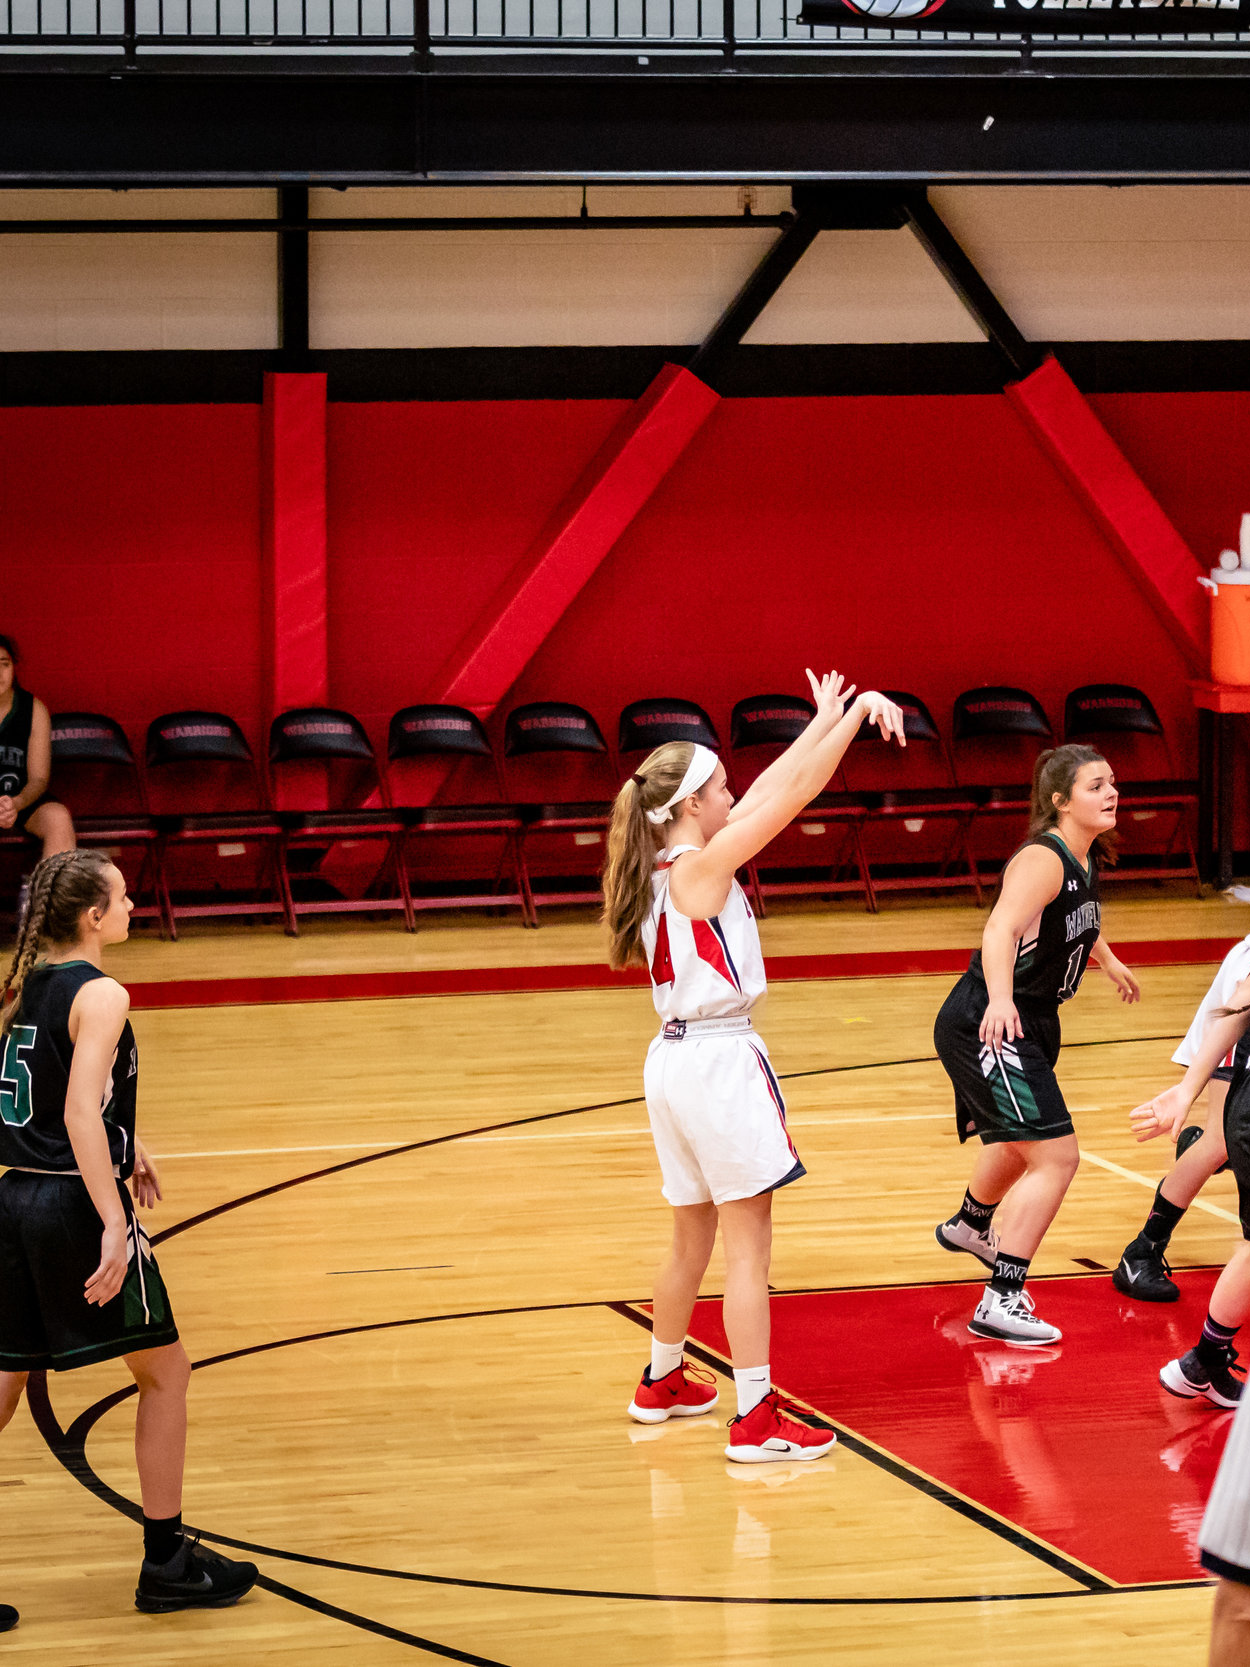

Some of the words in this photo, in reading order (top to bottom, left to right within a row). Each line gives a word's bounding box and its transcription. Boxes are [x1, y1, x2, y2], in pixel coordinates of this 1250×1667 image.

[632, 713, 701, 727] WARRIORS
[742, 709, 811, 723] WARRIORS
[283, 722, 352, 736] WARRIORS
[403, 719, 472, 732] WARRIORS
[518, 717, 587, 731] WARRIORS
[160, 724, 232, 739] WARRIORS
[0, 1024, 37, 1127] 5
